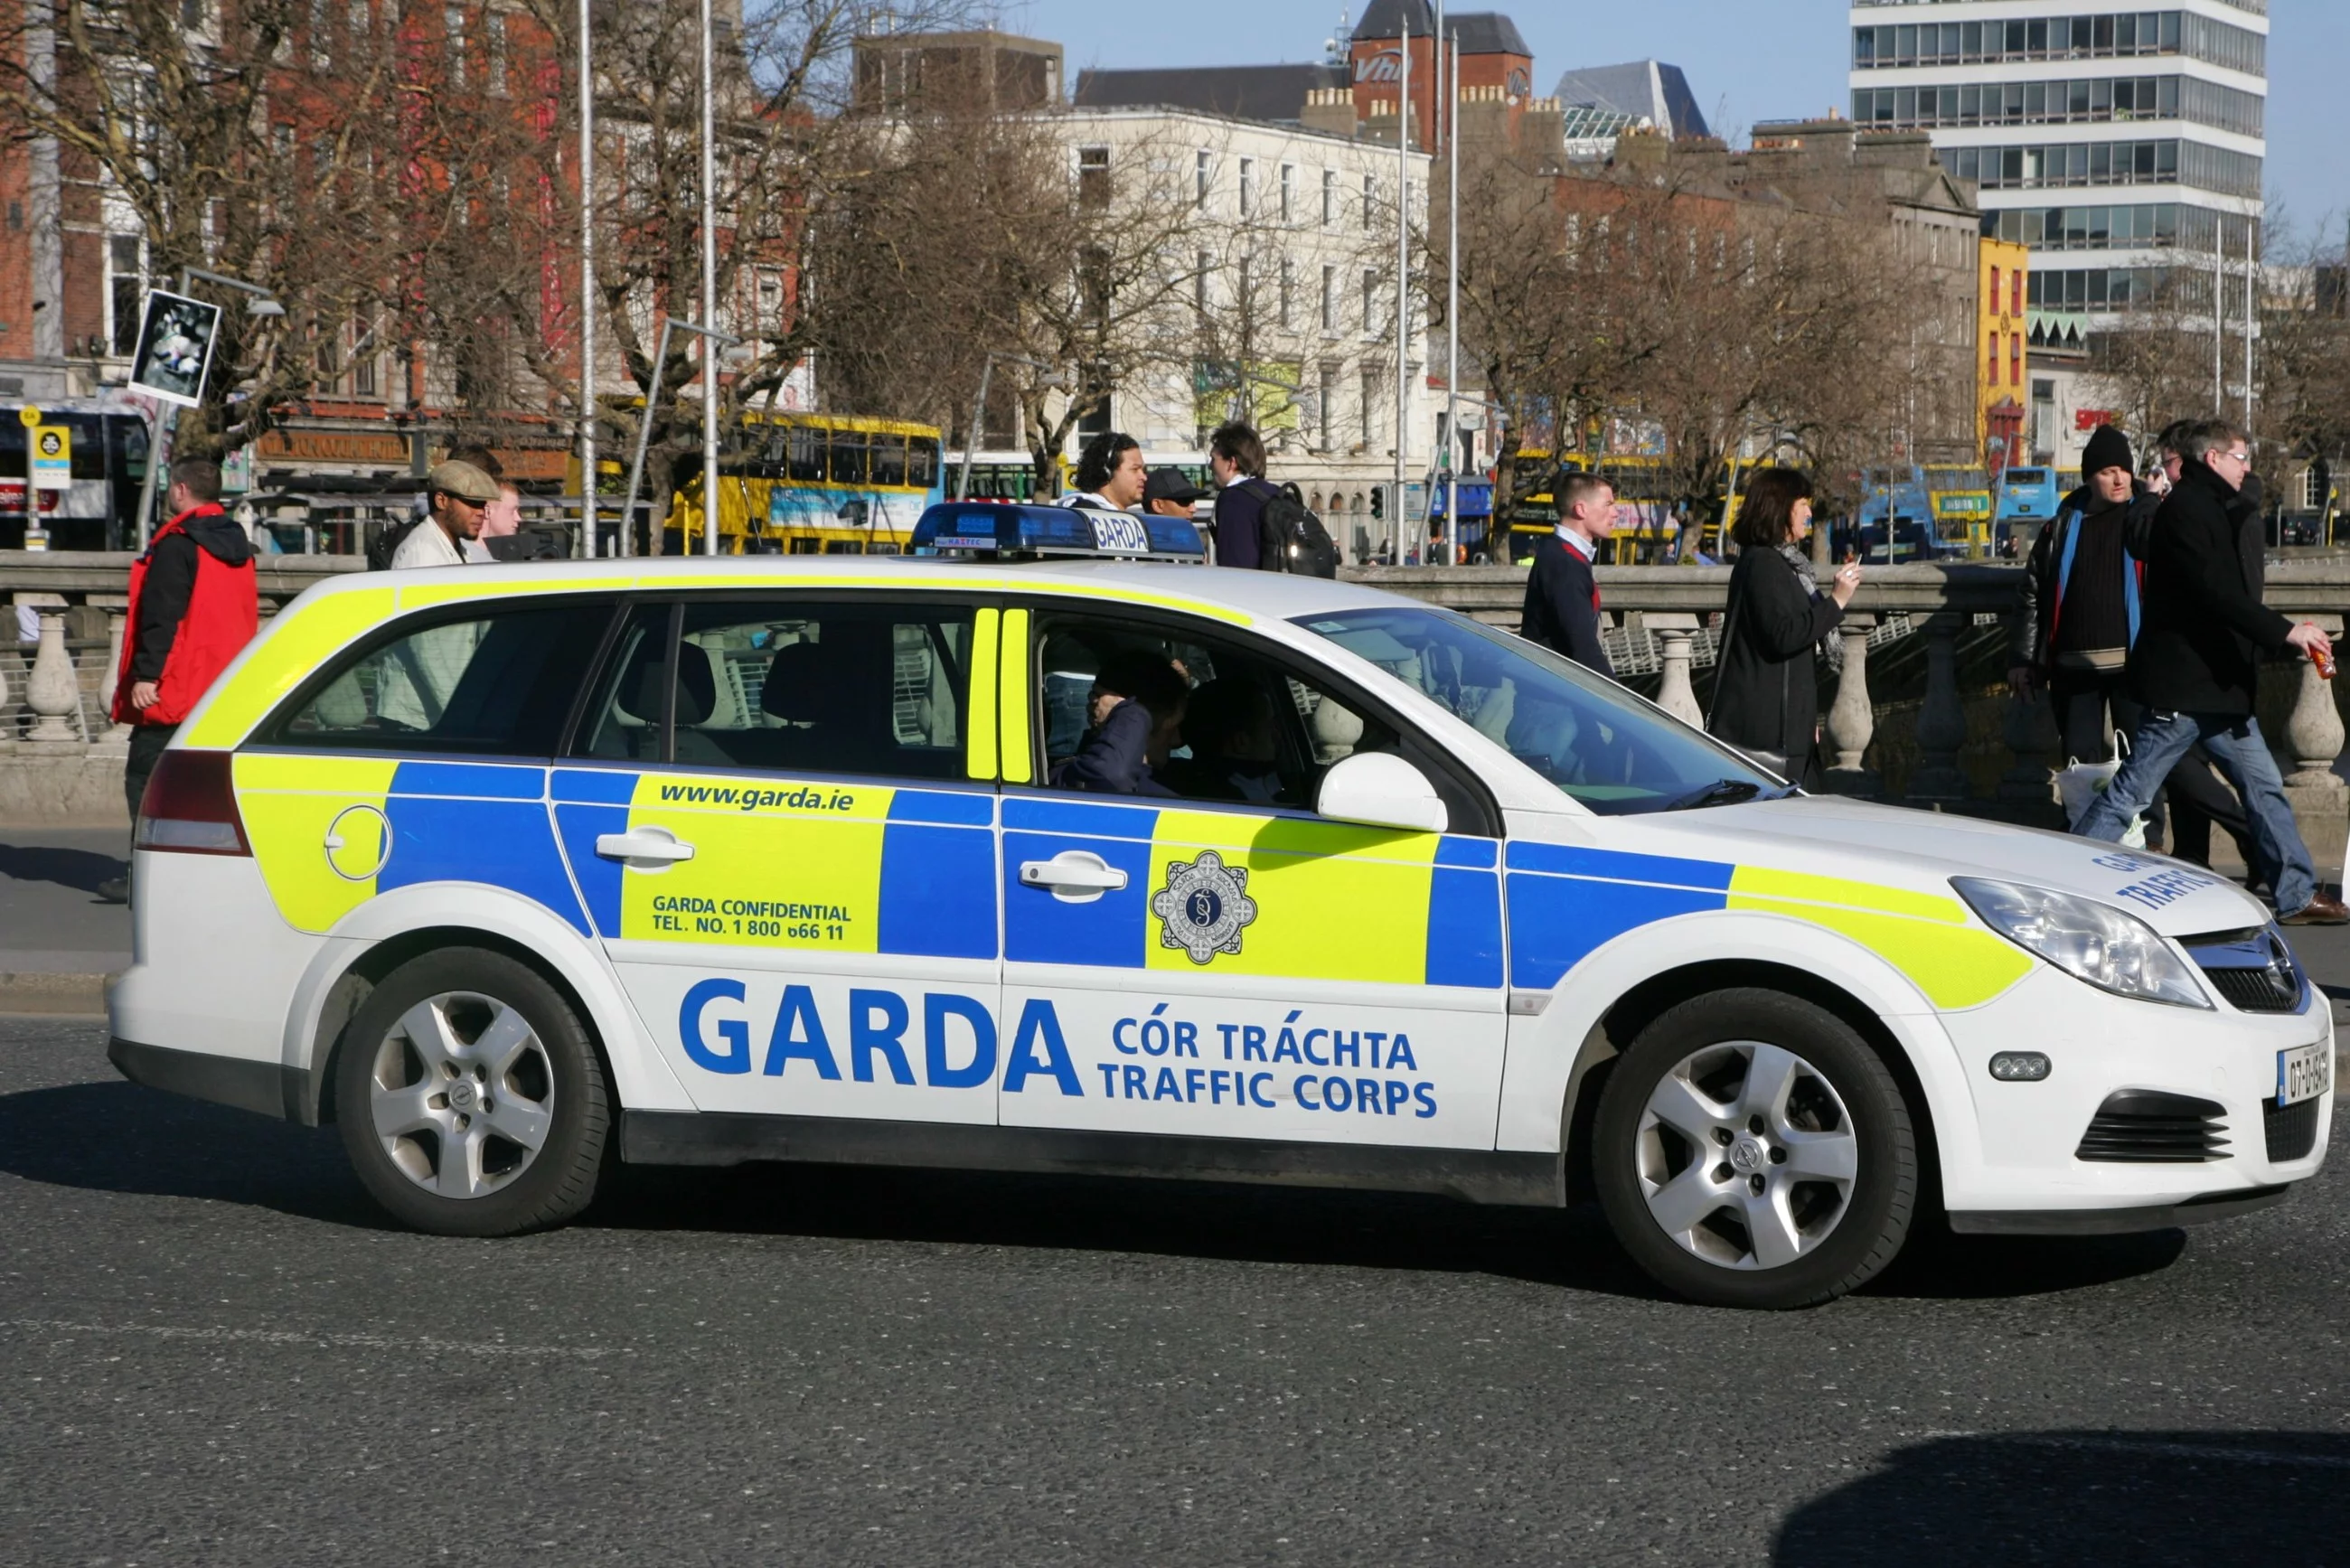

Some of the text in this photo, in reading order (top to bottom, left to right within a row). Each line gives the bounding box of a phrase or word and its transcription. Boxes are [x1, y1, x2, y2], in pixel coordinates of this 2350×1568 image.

[1091, 516, 1147, 549] GARDA
[661, 784, 854, 812] www.garda.ie
[2115, 869, 2214, 911] TRAFFIC
[653, 896, 851, 922] GARDA CONFIDENTIAL
[653, 915, 689, 932] TEL.
[696, 917, 727, 934] NO.
[733, 919, 741, 934] 1
[747, 920, 781, 937] 800
[826, 925, 843, 941] 11
[679, 978, 1085, 1097] GARDA
[1112, 1002, 1418, 1071] CÓR TRÁCHTA
[1096, 1063, 1437, 1119] TRAFFIC CORPS
